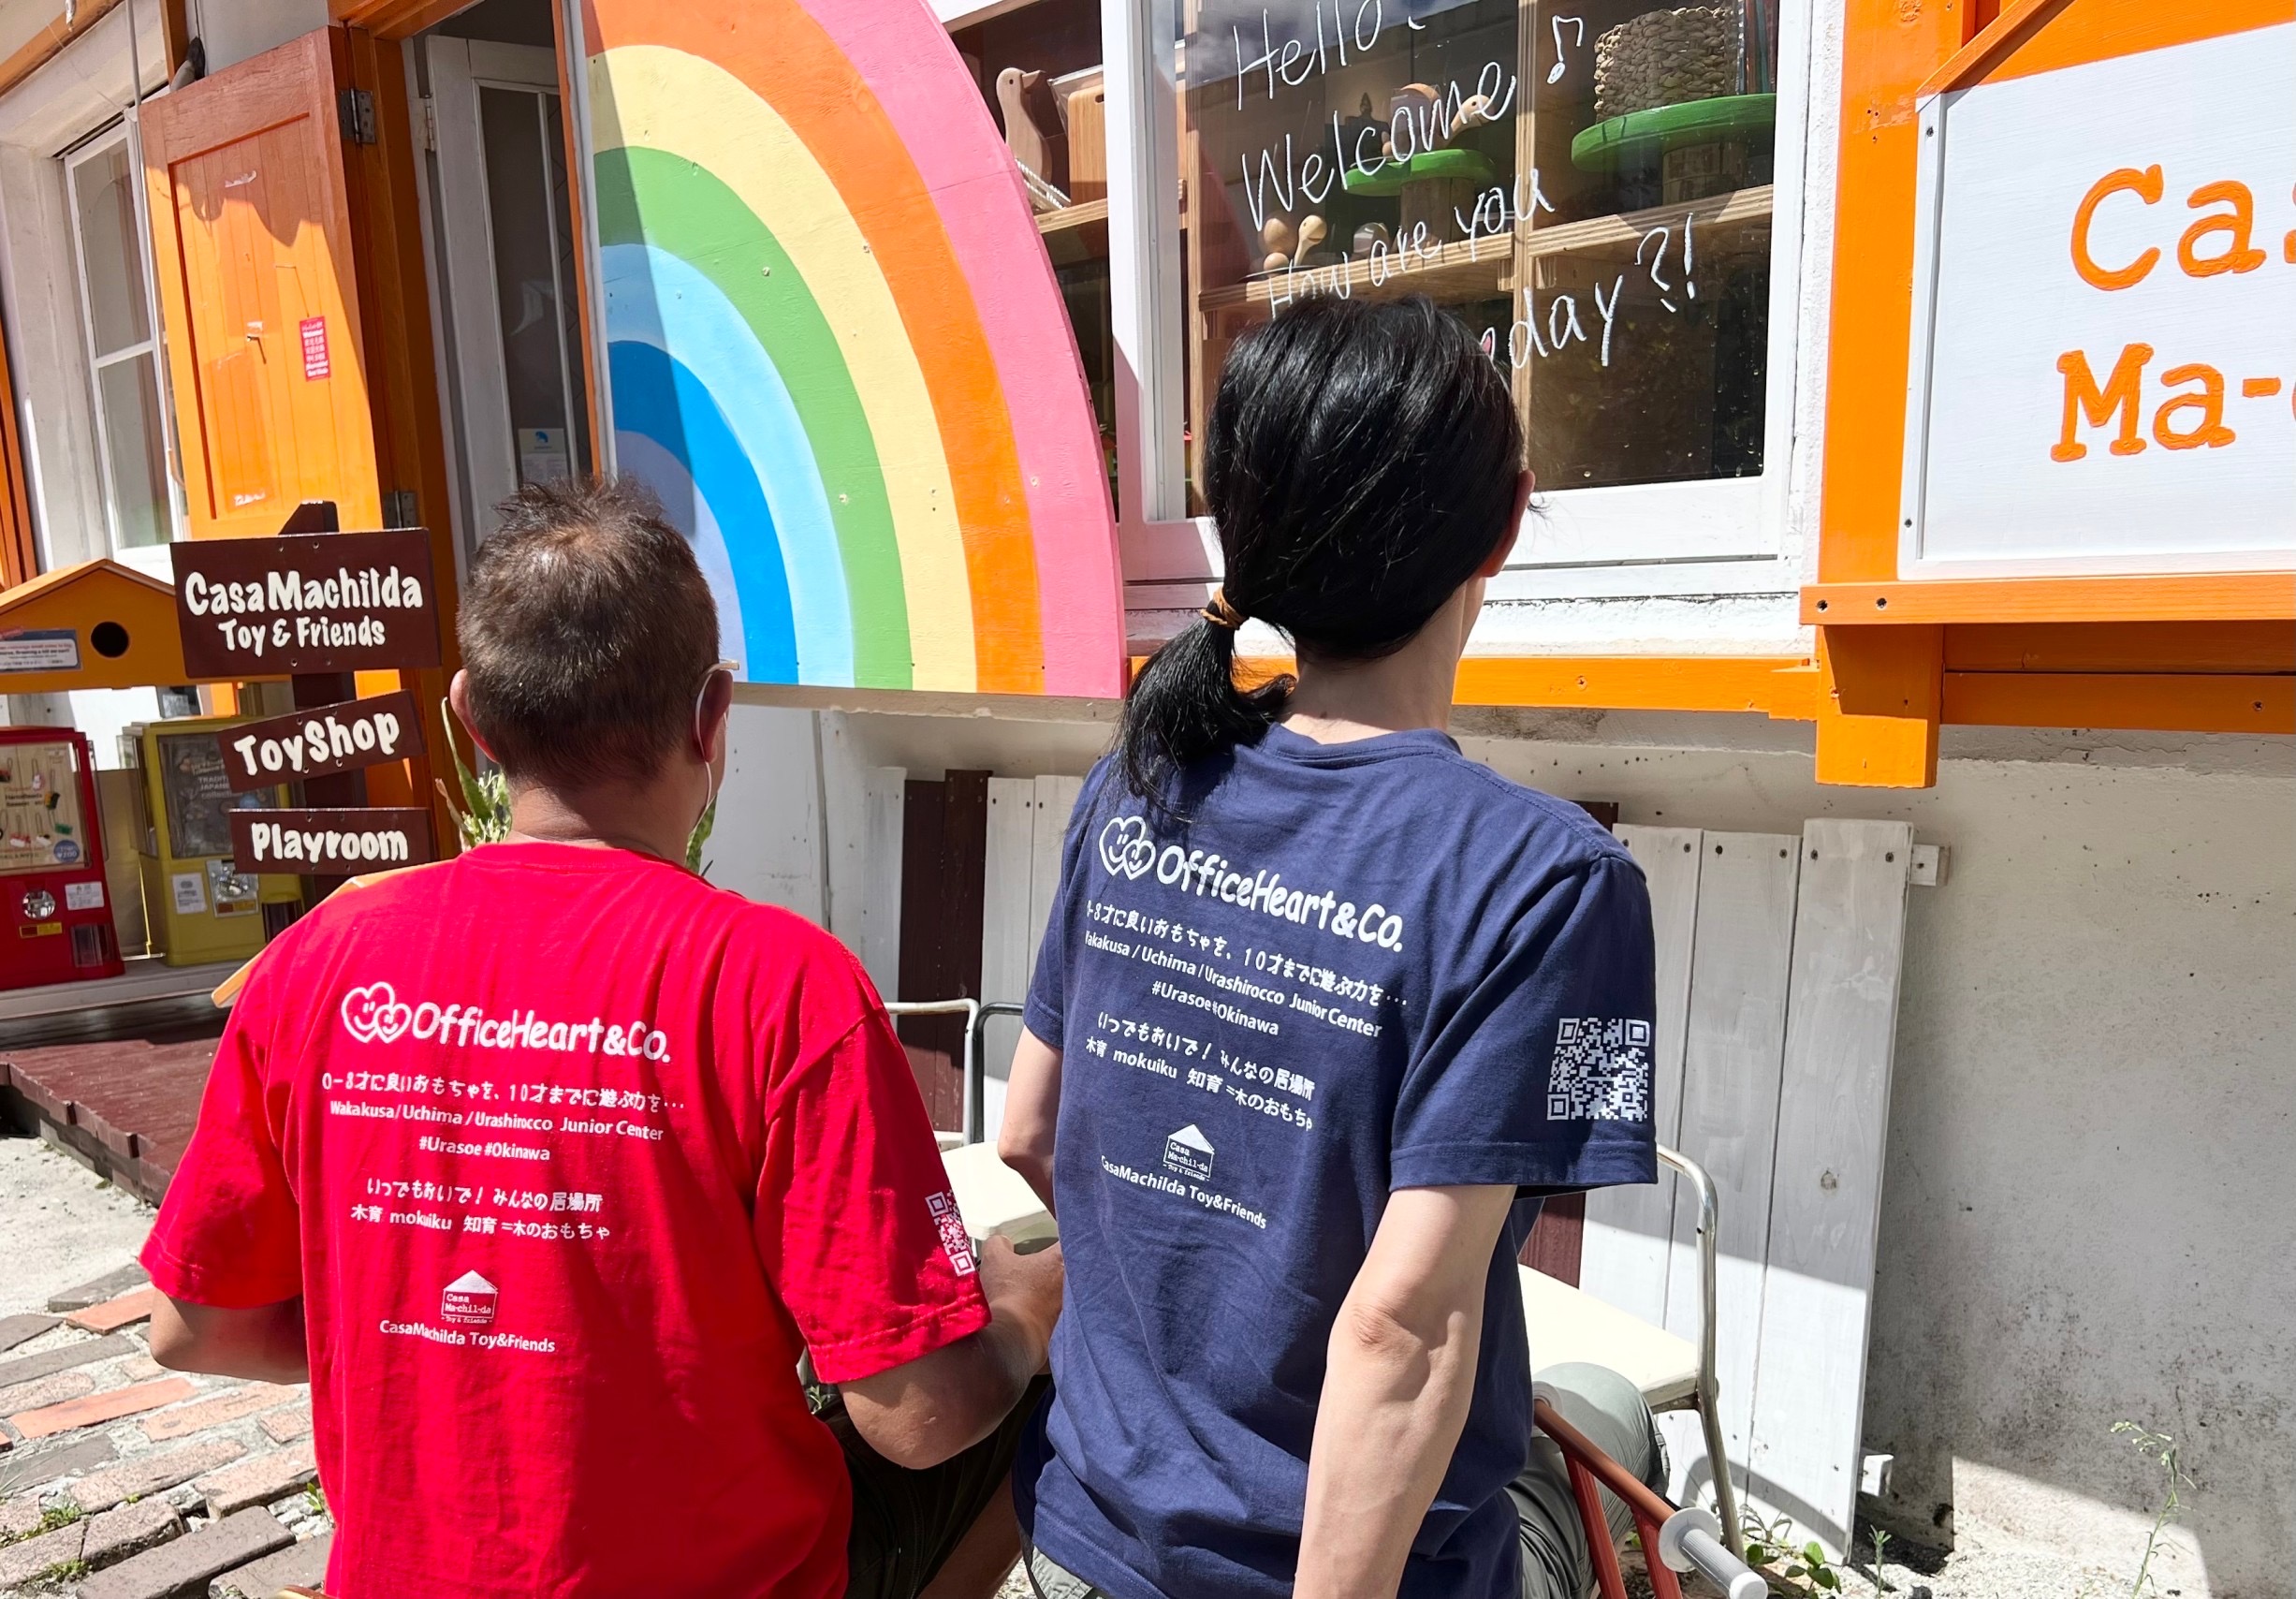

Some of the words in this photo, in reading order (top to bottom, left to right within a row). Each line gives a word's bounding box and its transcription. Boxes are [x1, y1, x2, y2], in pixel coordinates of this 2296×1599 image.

[1241, 61, 1517, 231] Welcome
[1369, 221, 1442, 286] are
[1454, 168, 1555, 262] you
[2070, 164, 2296, 290] Ca
[218, 618, 266, 657] Toy
[272, 618, 292, 648] &
[296, 615, 386, 648] Friends
[251, 822, 409, 863] Playroom
[1288, 992, 1327, 1020] Junior
[1327, 1007, 1382, 1038] Center
[1113, 1049, 1177, 1079] mokuiku
[418, 1136, 481, 1156] #Urasoe
[485, 1141, 550, 1161] #Okinawa
[560, 1117, 613, 1135] Junior
[616, 1121, 664, 1141] Center
[389, 1210, 452, 1230] mokuiku
